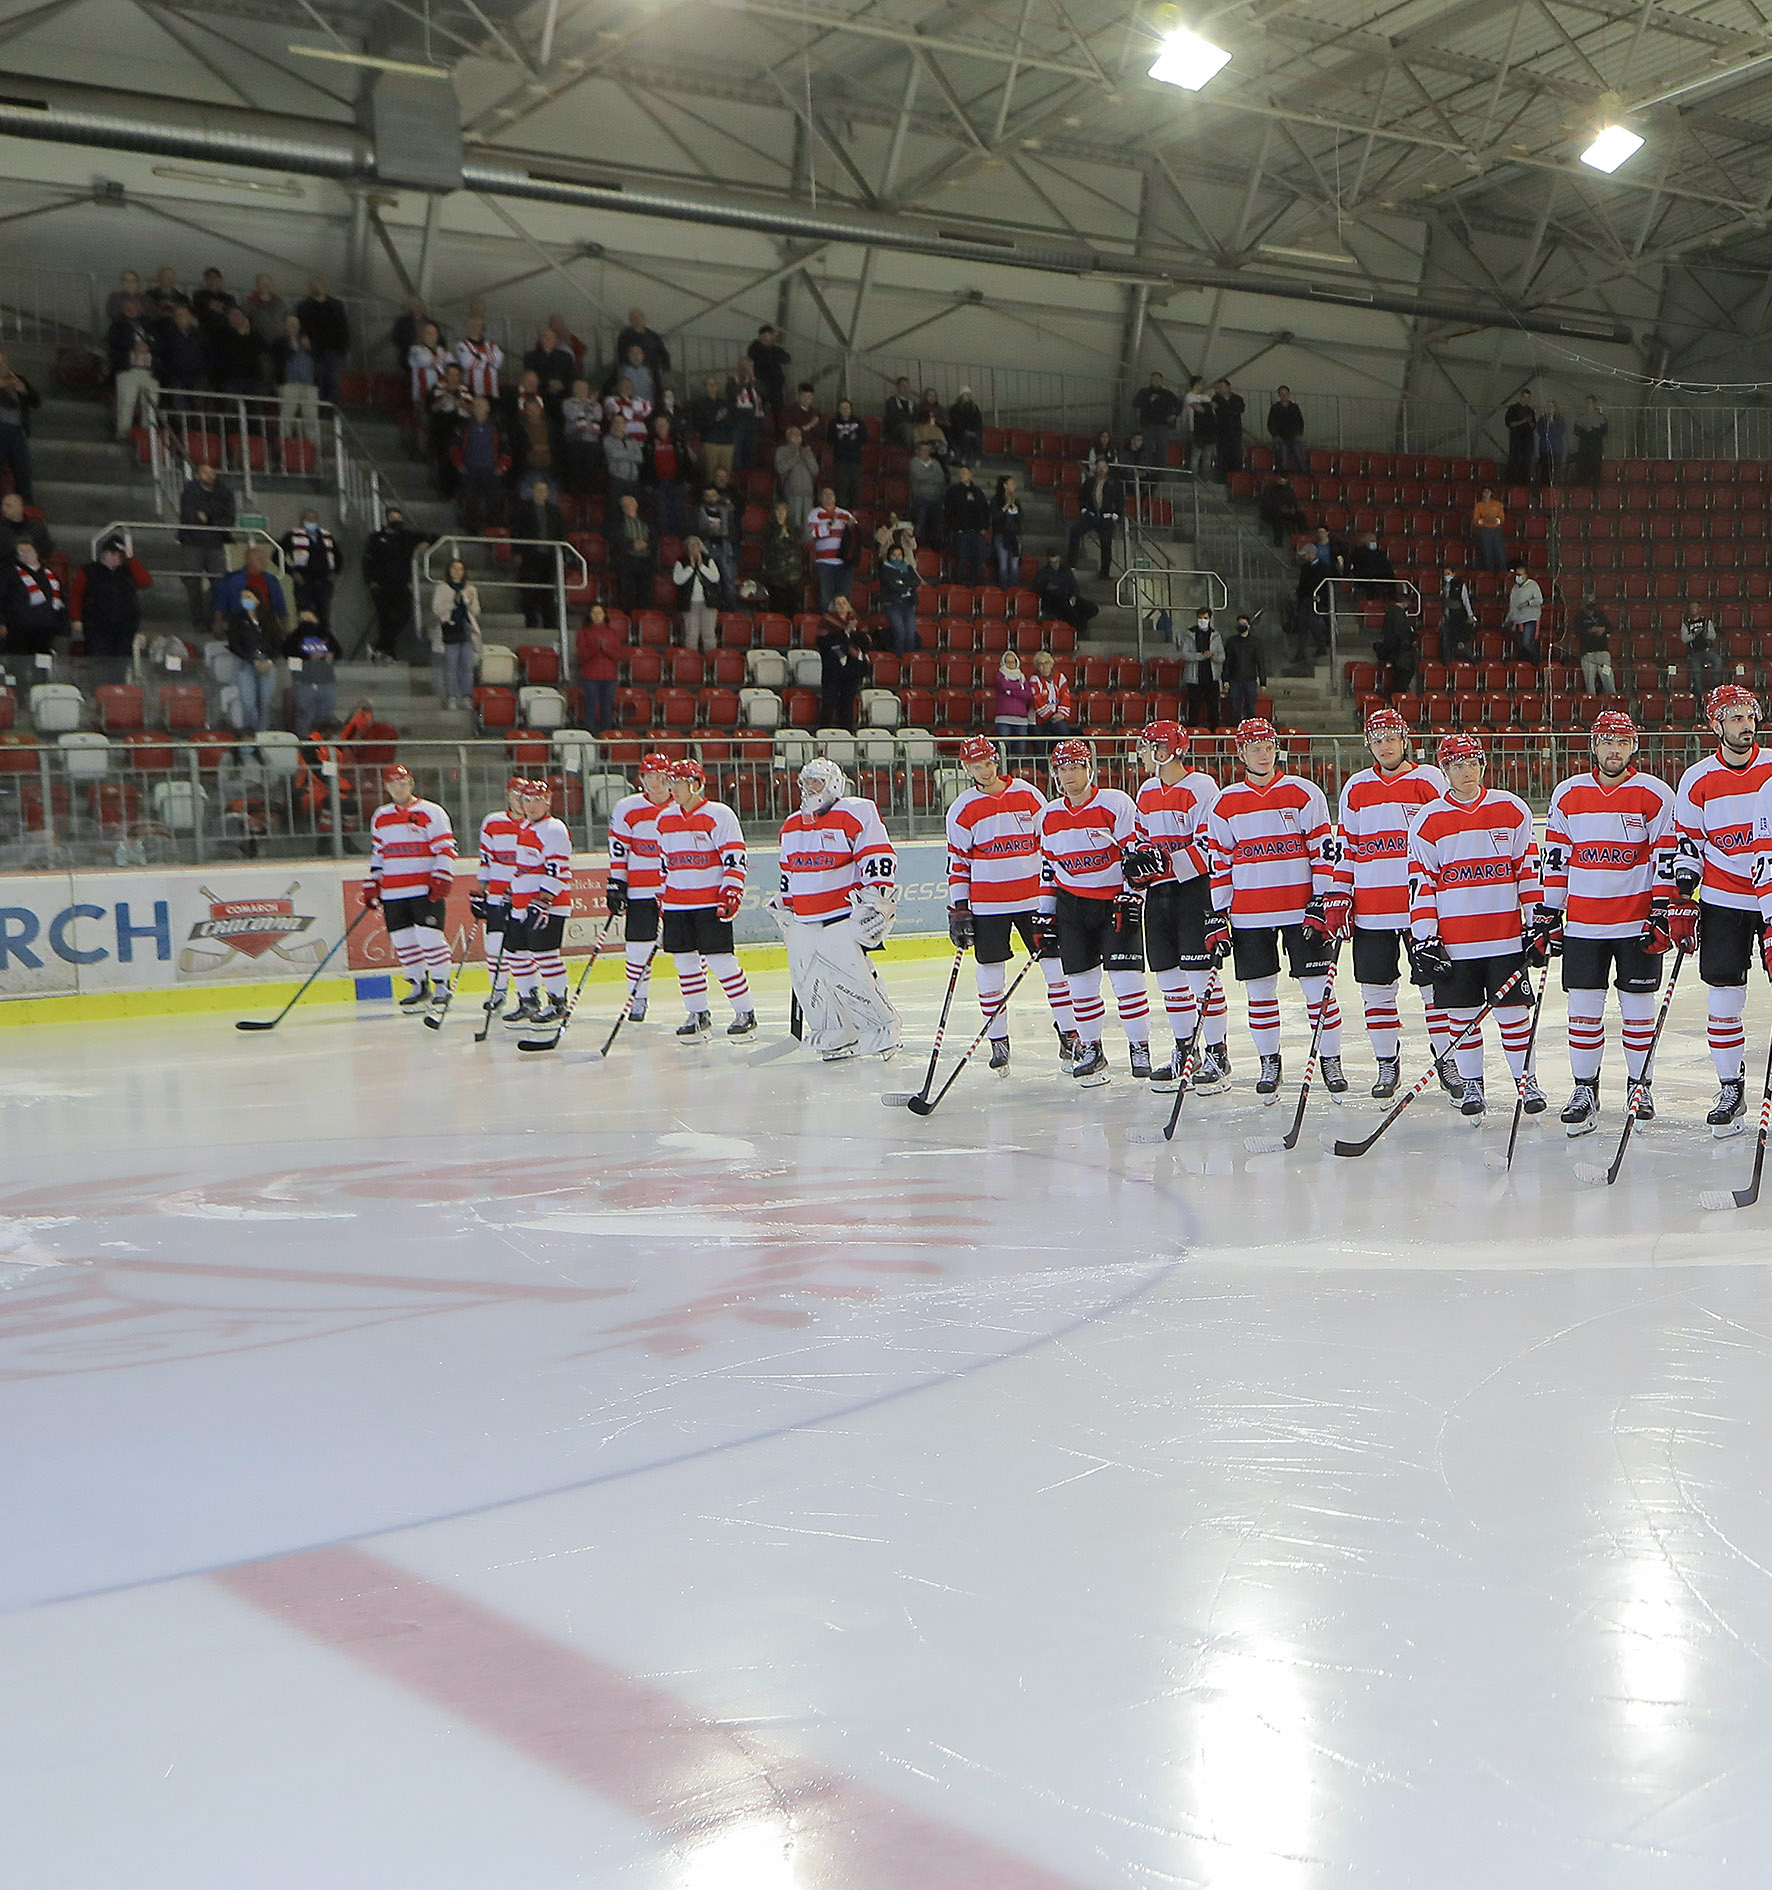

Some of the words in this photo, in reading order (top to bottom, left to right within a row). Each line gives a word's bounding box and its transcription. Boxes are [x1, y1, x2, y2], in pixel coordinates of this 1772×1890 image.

[1236, 840, 1304, 858] COMARCH
[864, 858, 893, 877] 48
[1061, 852, 1111, 871] MARCH
[225, 903, 279, 914] COMARCH
[1205, 917, 1227, 925] UER
[836, 983, 872, 1006] BAUER
